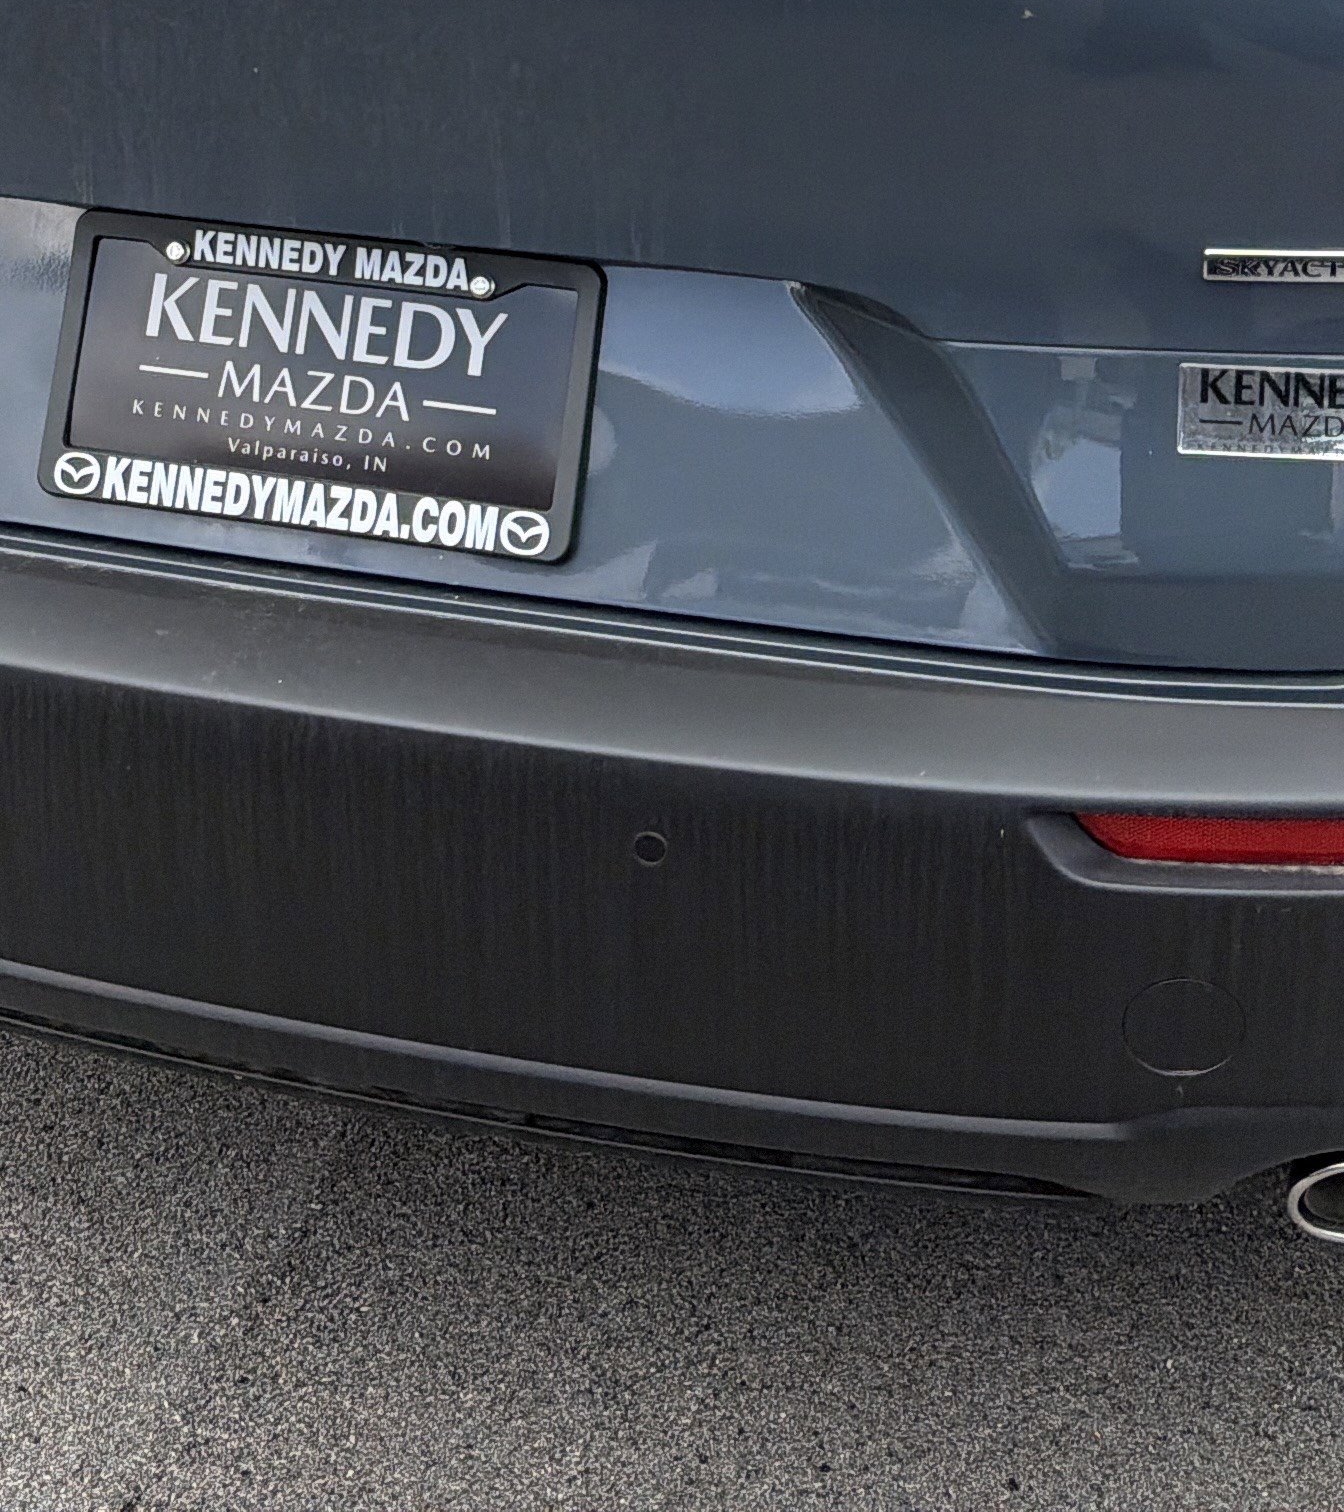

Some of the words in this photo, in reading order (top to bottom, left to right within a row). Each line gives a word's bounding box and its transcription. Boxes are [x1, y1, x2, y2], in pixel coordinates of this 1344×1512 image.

[193, 229, 348, 277] KENNEDY
[354, 245, 469, 292] MAZDA
[145, 272, 509, 377] KENNEDY
[216, 360, 411, 422] MAZDA
[131, 398, 492, 462] KENNEDYMAZDA.COM
[227, 436, 352, 471] Valparaiso,
[363, 454, 388, 473] IN
[101, 457, 501, 552] KENNEDYMAZDA.COM
